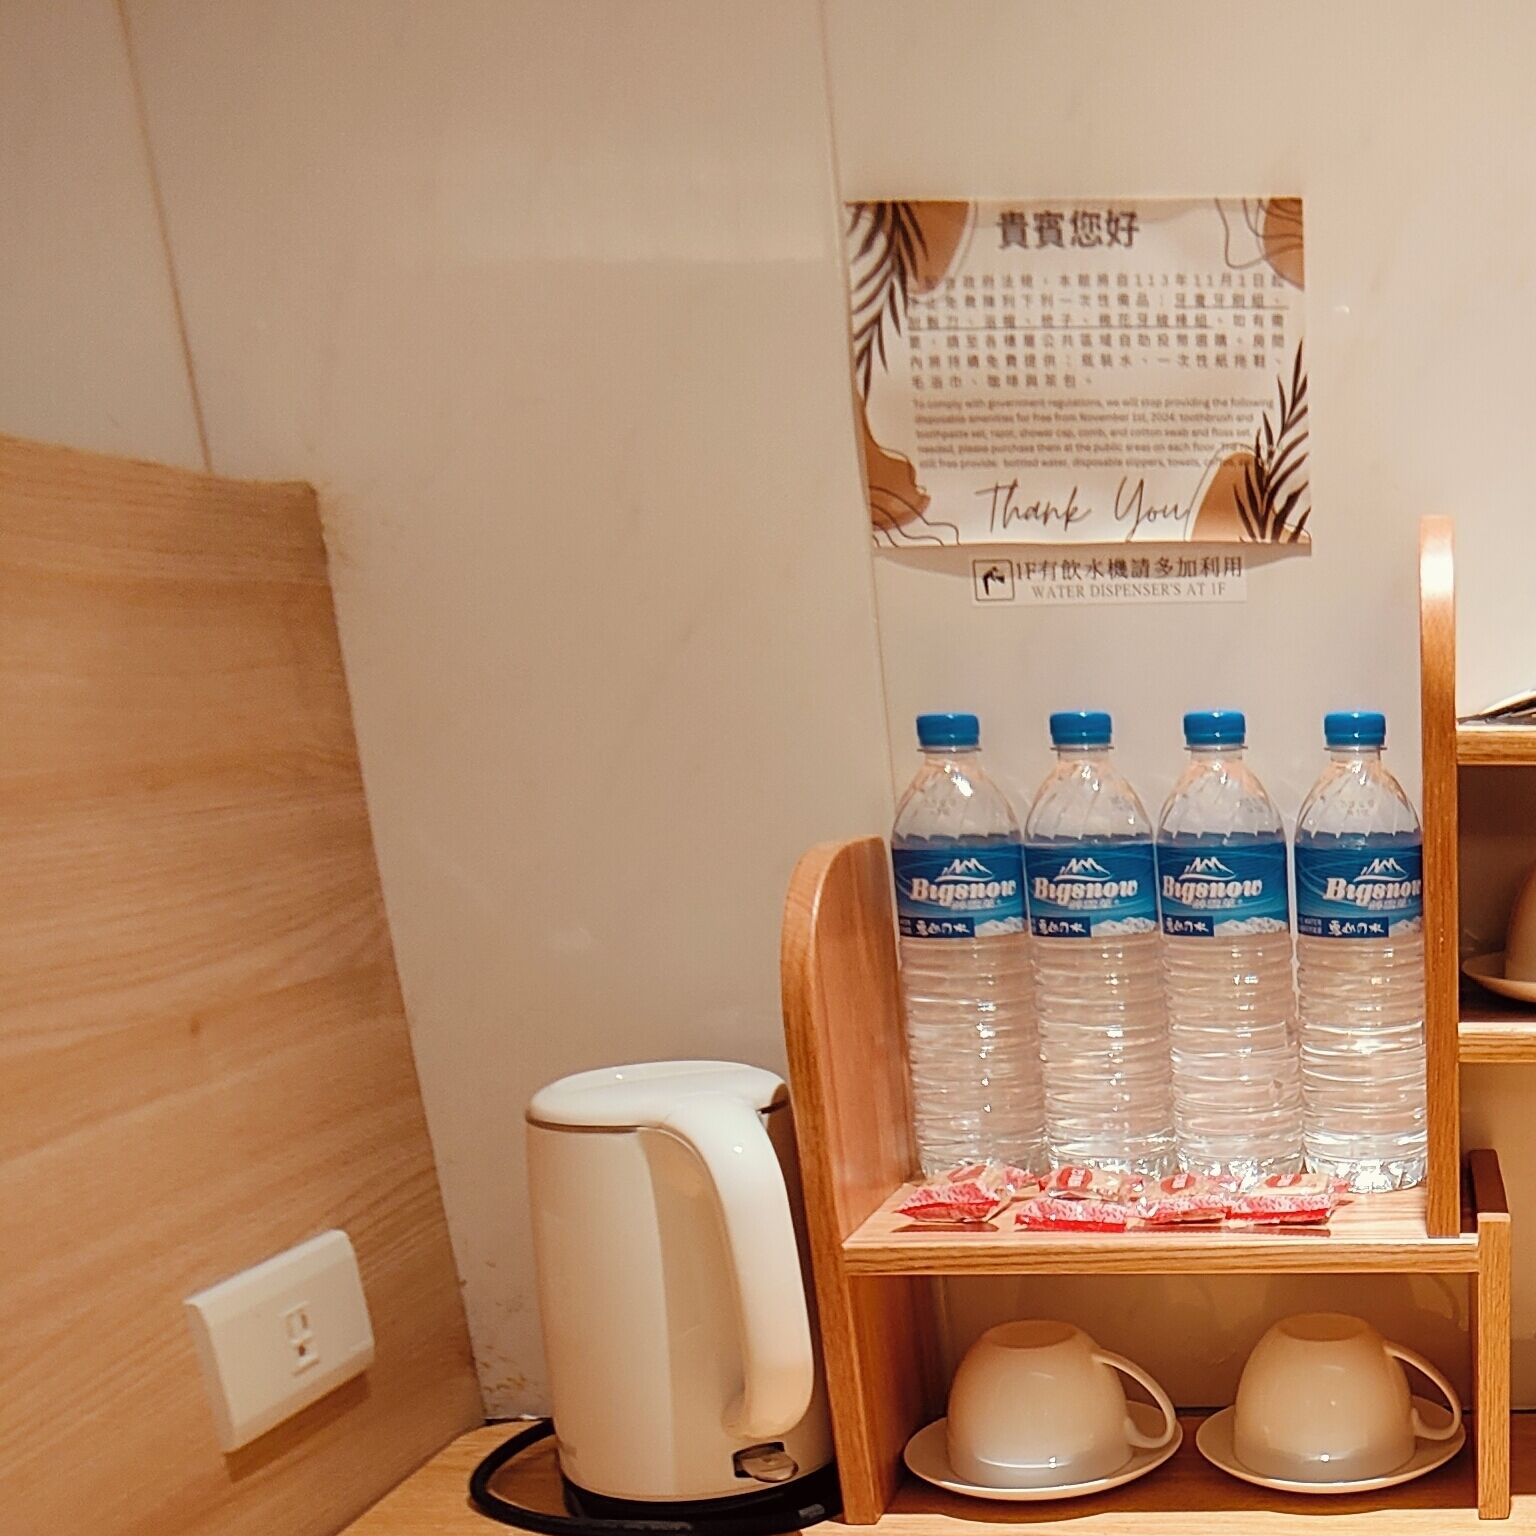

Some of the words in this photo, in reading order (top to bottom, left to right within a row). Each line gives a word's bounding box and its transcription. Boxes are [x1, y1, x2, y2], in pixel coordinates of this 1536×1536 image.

[997, 208, 1140, 249] 貴賓您好
[974, 479, 1092, 532] Thank
[1114, 475, 1189, 541] You
[1016, 556, 1242, 582] 1F有飲水機請多加利用
[1032, 584, 1085, 600] WATER
[1090, 582, 1181, 599] DISPENSER'S
[1187, 582, 1207, 598] AT
[911, 877, 1017, 907] Bigsnow
[1033, 877, 1138, 907] Bigsnow
[1162, 875, 1263, 904] Bigsnow
